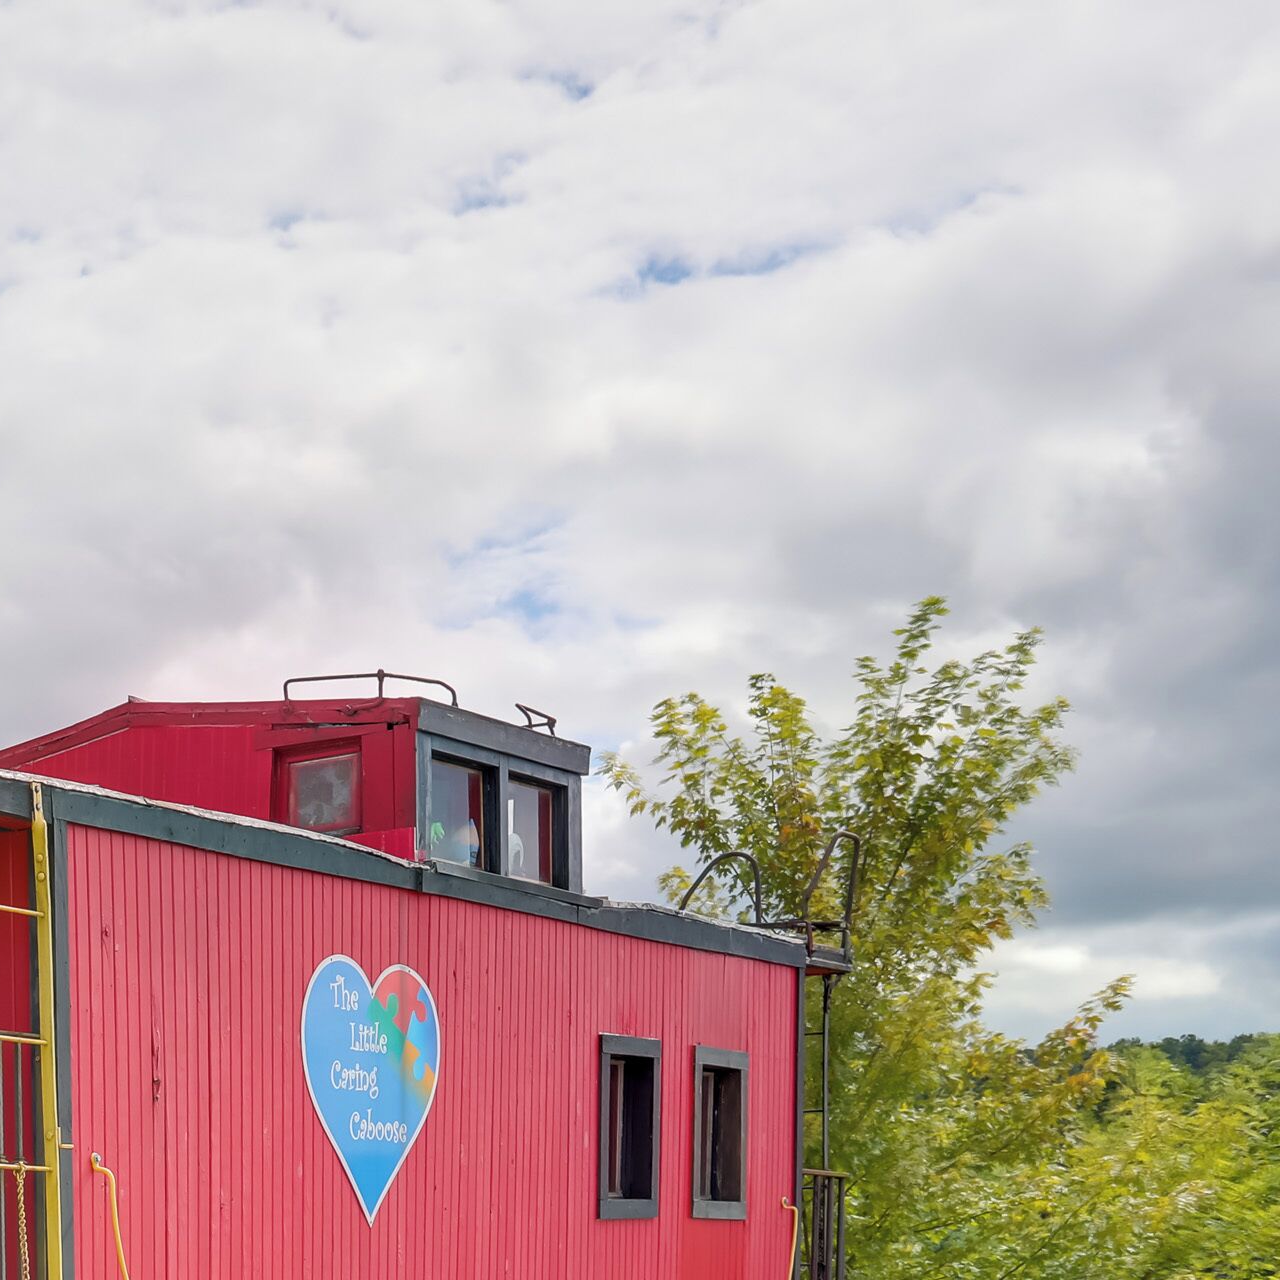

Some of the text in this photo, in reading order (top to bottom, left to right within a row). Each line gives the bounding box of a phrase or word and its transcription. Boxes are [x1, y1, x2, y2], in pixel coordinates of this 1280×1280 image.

[330, 974, 359, 1011] The
[349, 1021, 388, 1054] Little
[330, 1060, 379, 1099] Caring
[349, 1109, 407, 1143] Caboose
